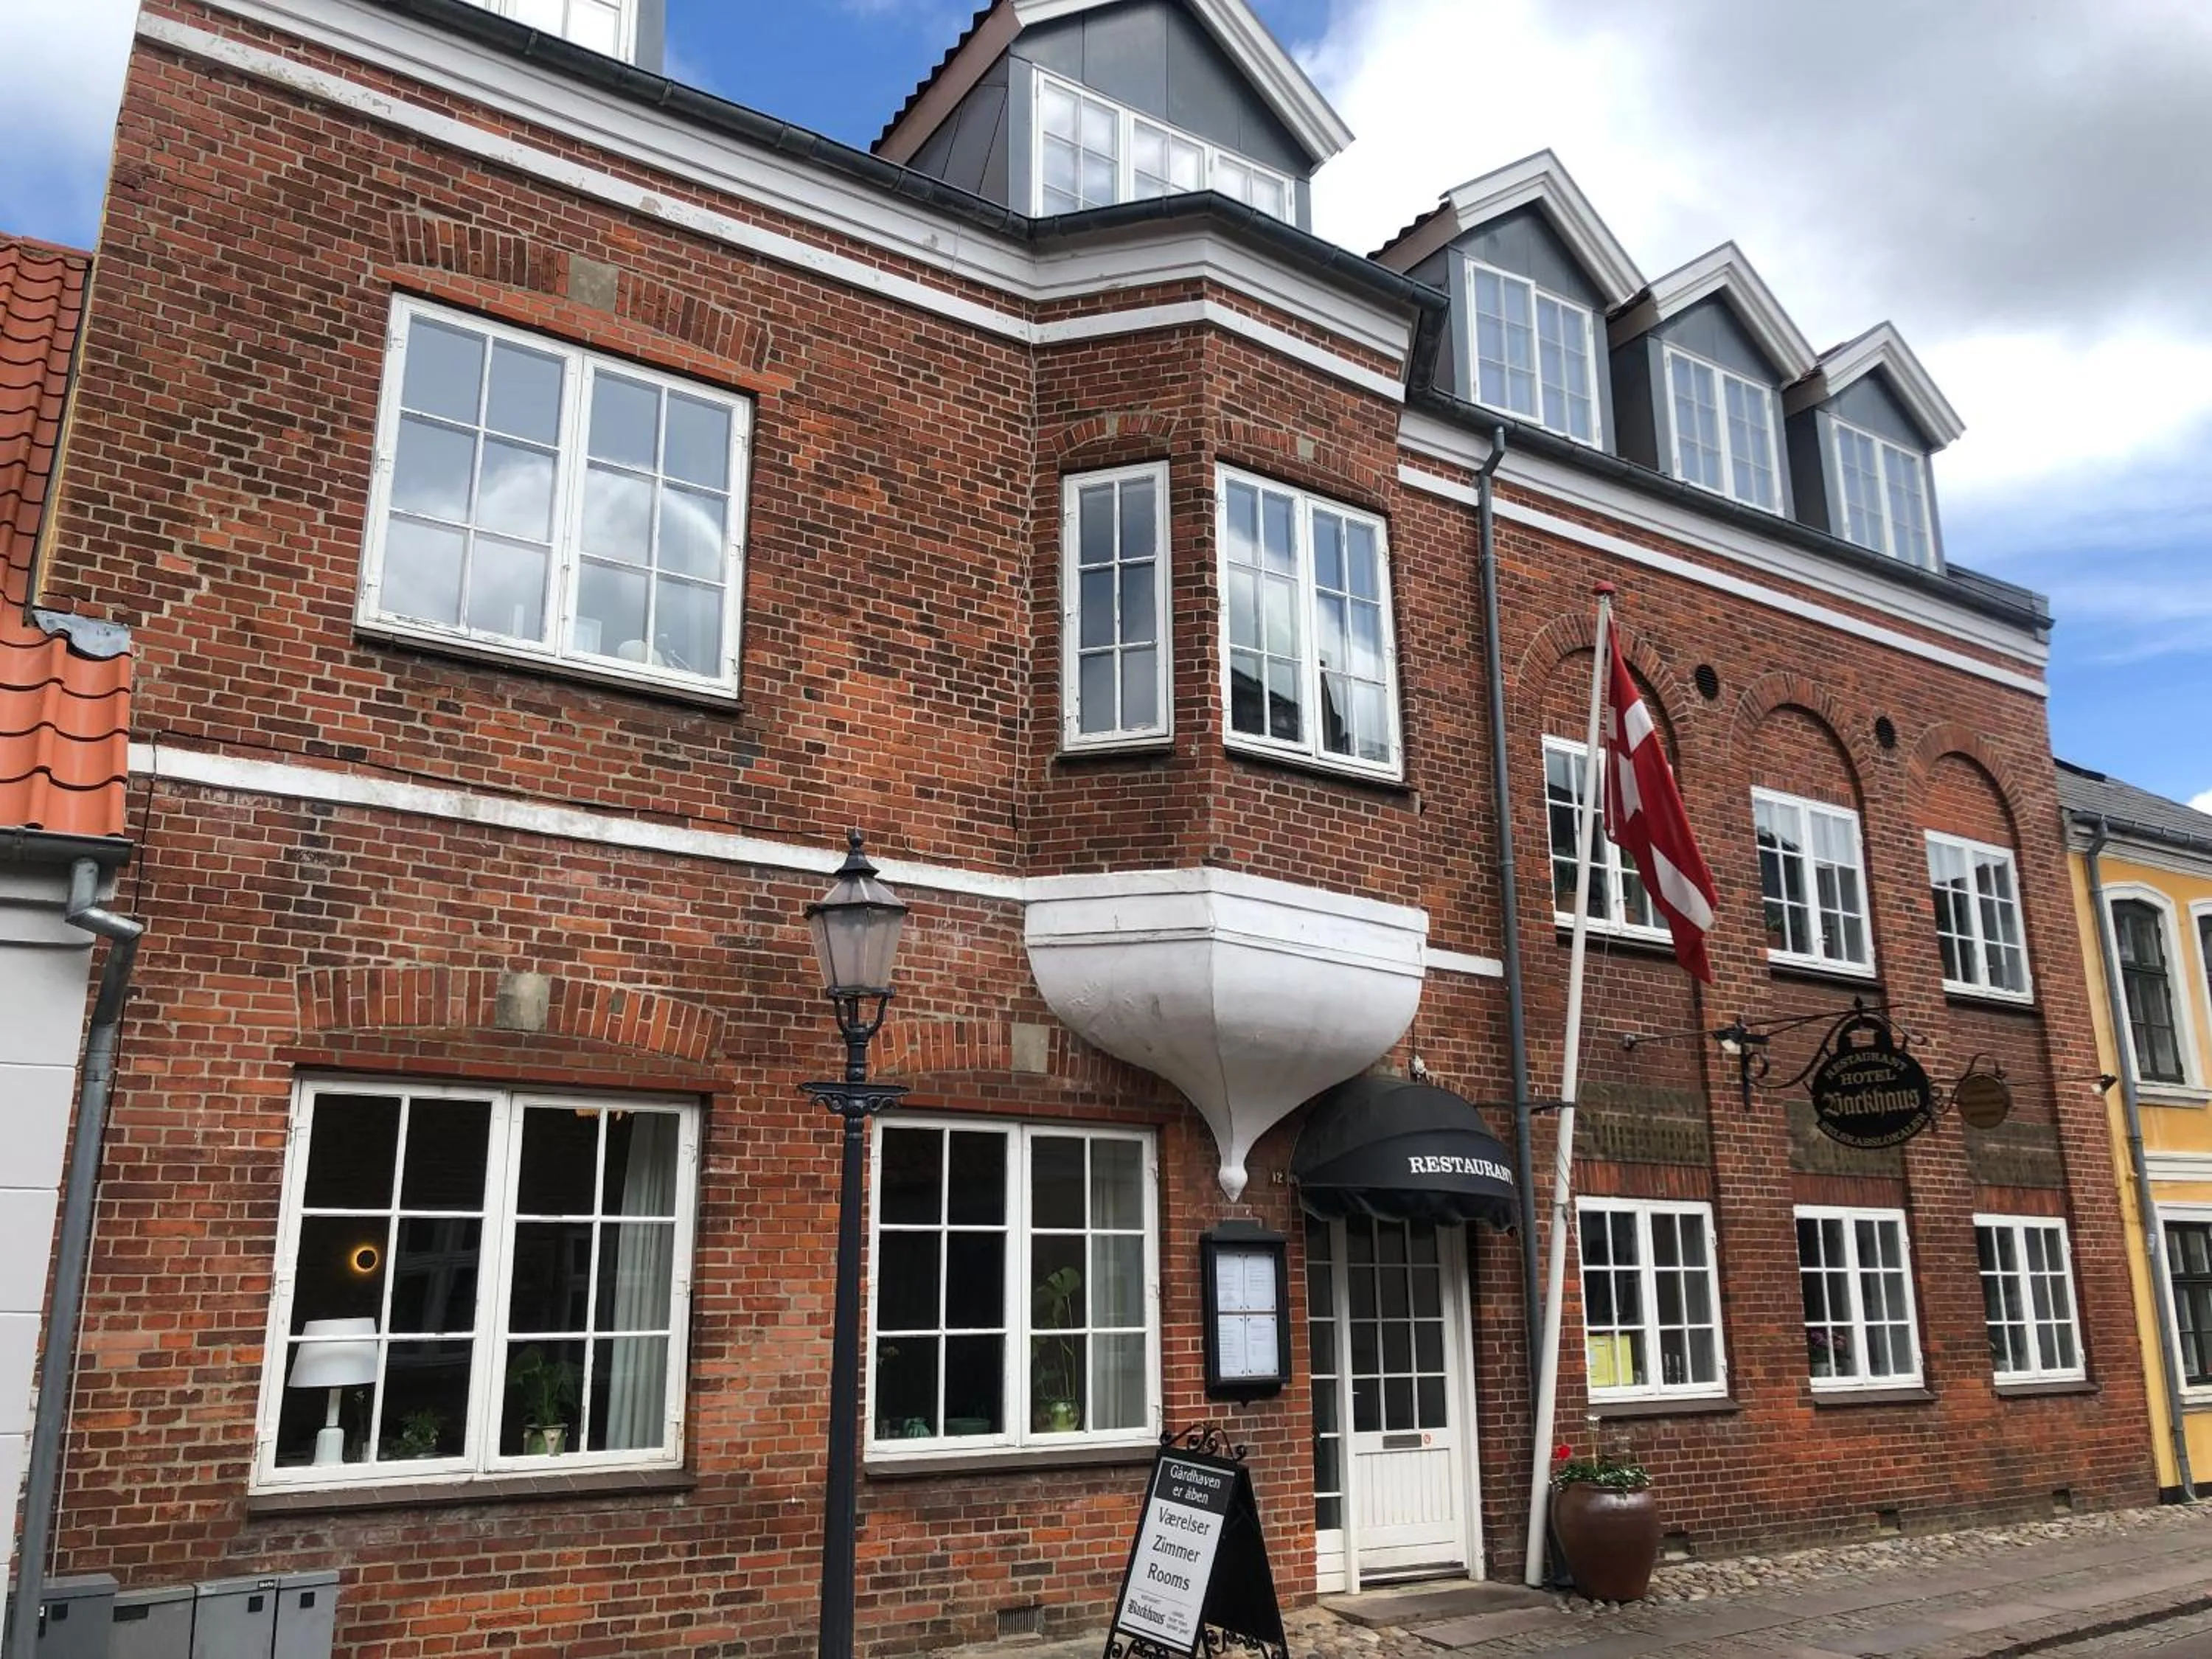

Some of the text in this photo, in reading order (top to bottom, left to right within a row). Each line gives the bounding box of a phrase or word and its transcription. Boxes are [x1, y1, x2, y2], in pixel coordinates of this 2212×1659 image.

[1840, 1068, 1896, 1085] HOTEL
[1408, 1155, 1514, 1186] RESTAURANT
[1169, 1464, 1221, 1489] Gårdhaven
[1172, 1486, 1208, 1504] er åben
[1158, 1506, 1211, 1535] Værelser
[1152, 1534, 1201, 1563] Zimmer
[1147, 1562, 1191, 1591] Rooms
